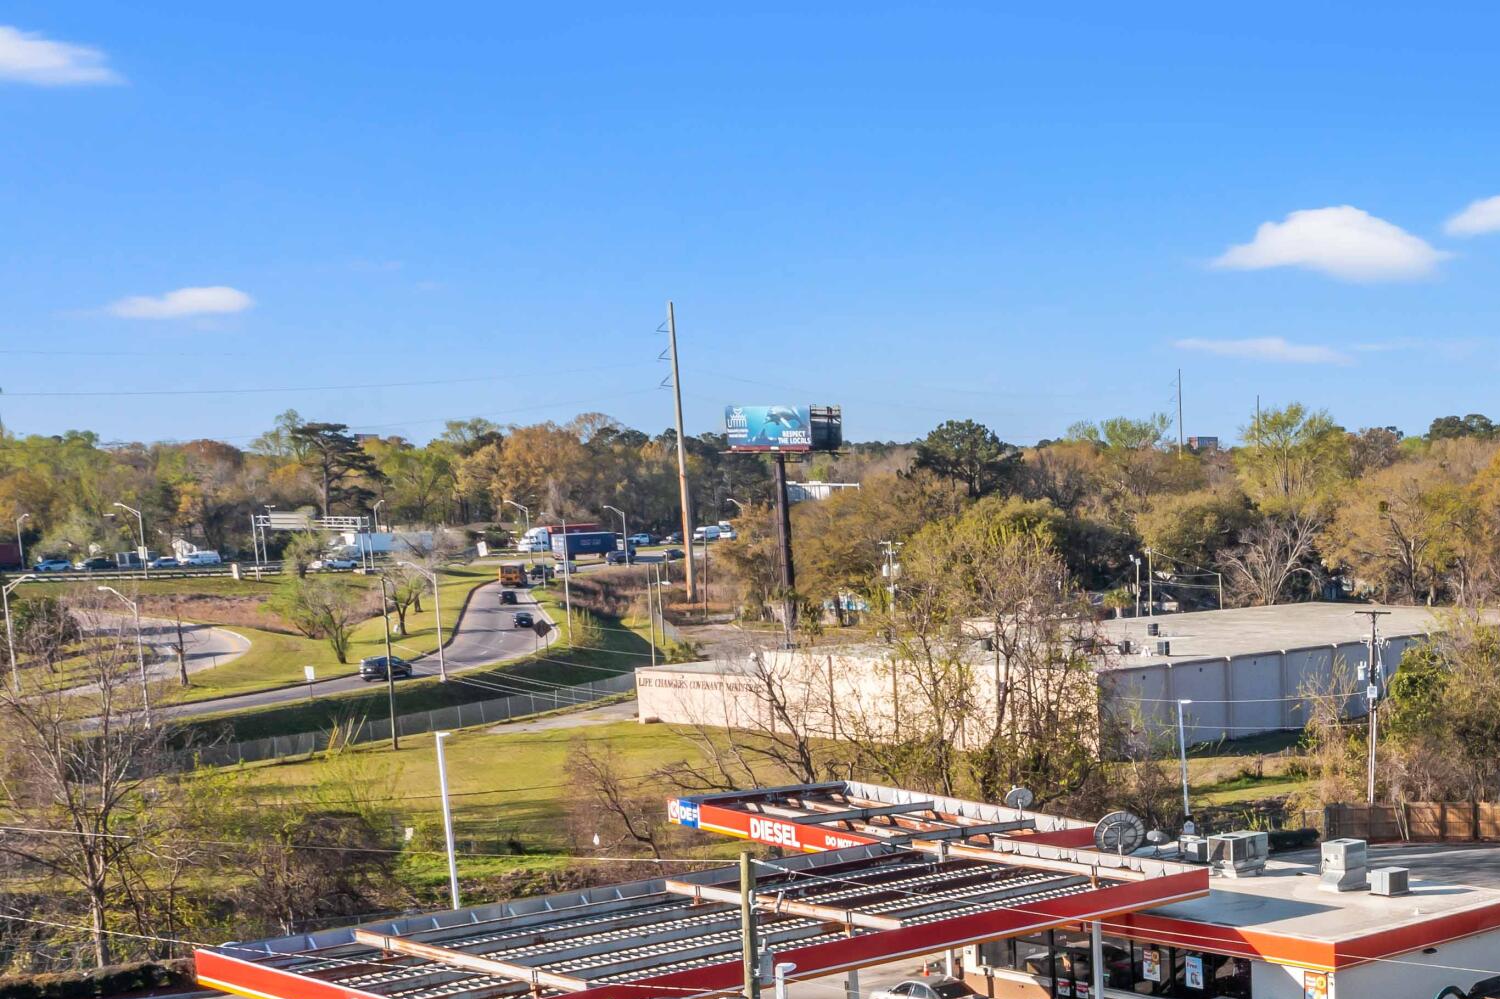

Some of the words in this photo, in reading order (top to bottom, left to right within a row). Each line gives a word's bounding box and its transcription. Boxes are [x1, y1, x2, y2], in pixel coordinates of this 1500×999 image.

[639, 678, 653, 687] LIFE
[690, 681, 723, 691] COVENANT
[680, 806, 697, 821] DEF
[750, 818, 800, 848] DIESEL
[825, 835, 837, 847] DO
